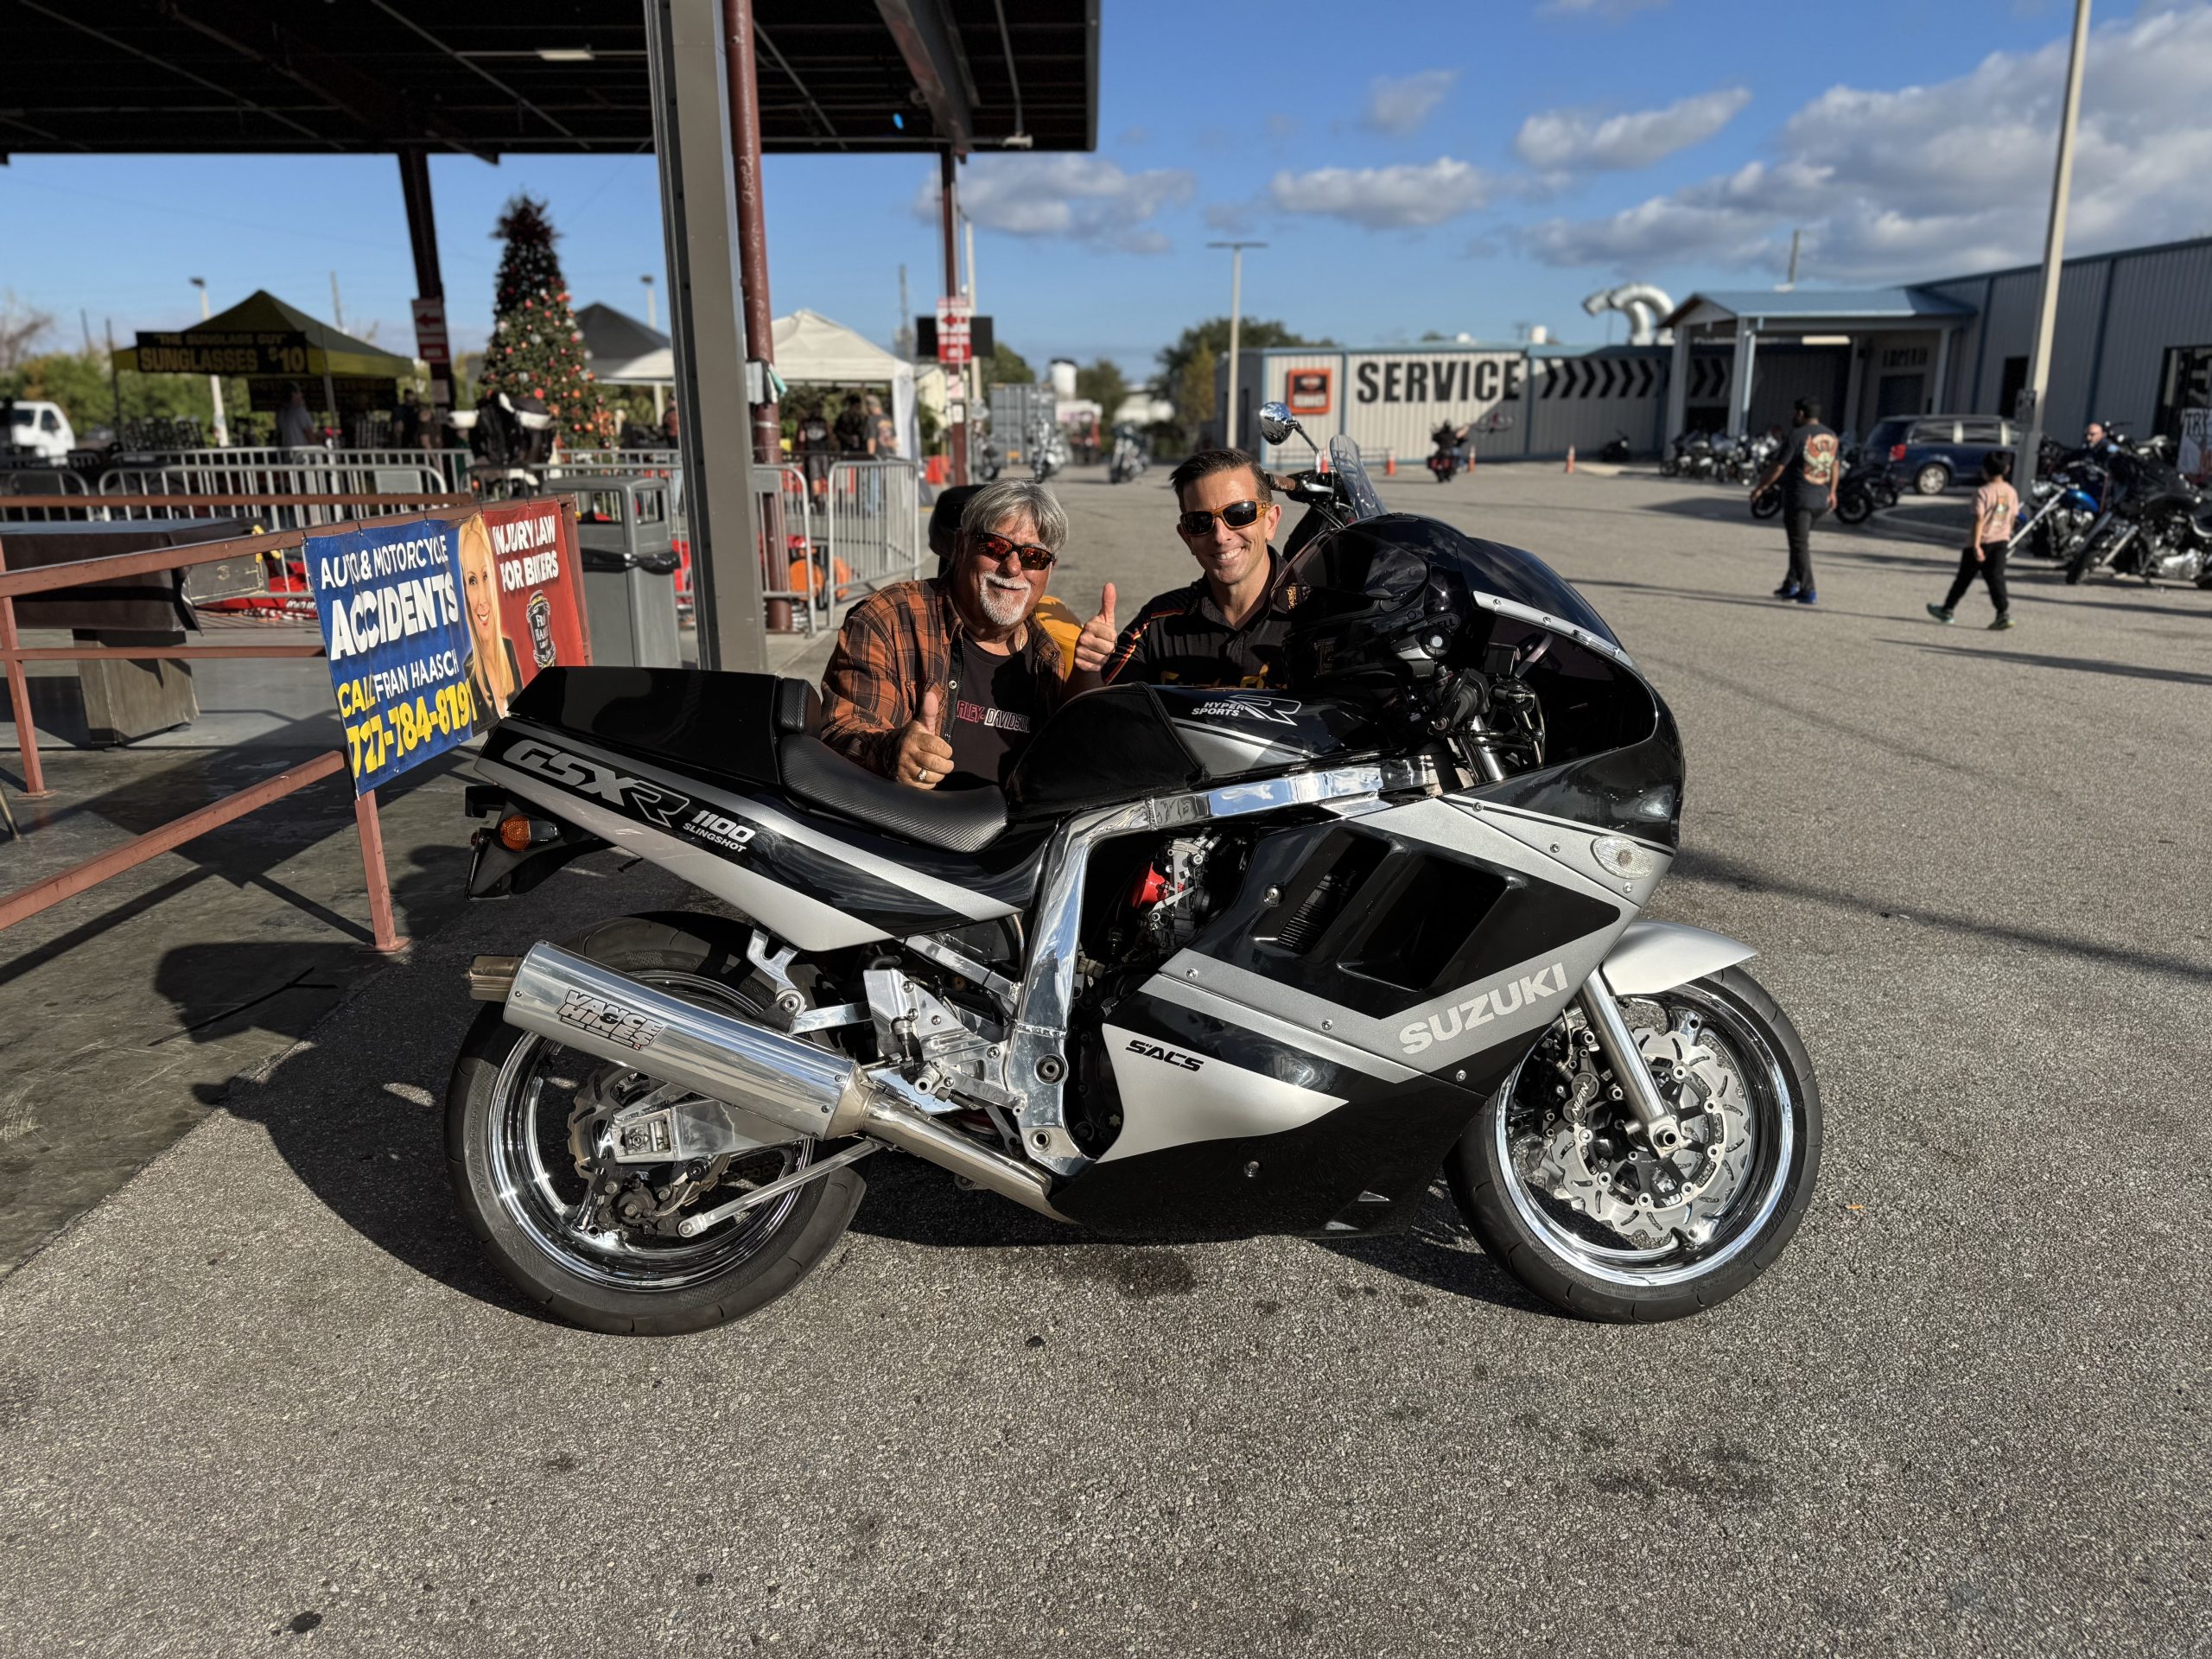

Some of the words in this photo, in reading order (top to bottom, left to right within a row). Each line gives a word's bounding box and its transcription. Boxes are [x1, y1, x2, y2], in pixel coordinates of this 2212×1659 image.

[140, 347, 258, 372] SUNGLASSES
[267, 347, 304, 372] $10
[1357, 359, 1522, 404] SERVICE
[492, 519, 534, 556] INJURY
[534, 515, 556, 546] LAW
[321, 552, 360, 590] AUTO
[360, 550, 372, 581] &
[373, 535, 449, 577] MOTORCYCLE
[499, 560, 524, 593] FOR
[523, 550, 559, 586] BIKERS
[330, 572, 459, 661] ACCIDENTS
[337, 674, 376, 718] CALL
[373, 664, 409, 702] FRAN
[410, 648, 460, 688] HAASCH
[346, 677, 477, 779] 727-784-8191
[1191, 707, 1240, 716] SPORTS
[1204, 702, 1246, 711] HYPER
[682, 822, 747, 853] SLINGSHOT
[691, 810, 756, 843] 1100
[556, 1002, 654, 1046] HINES
[564, 988, 664, 1037] VANCE
[1397, 962, 1569, 1054] SUZUKI
[1571, 1081, 1589, 1116] NISSIN
